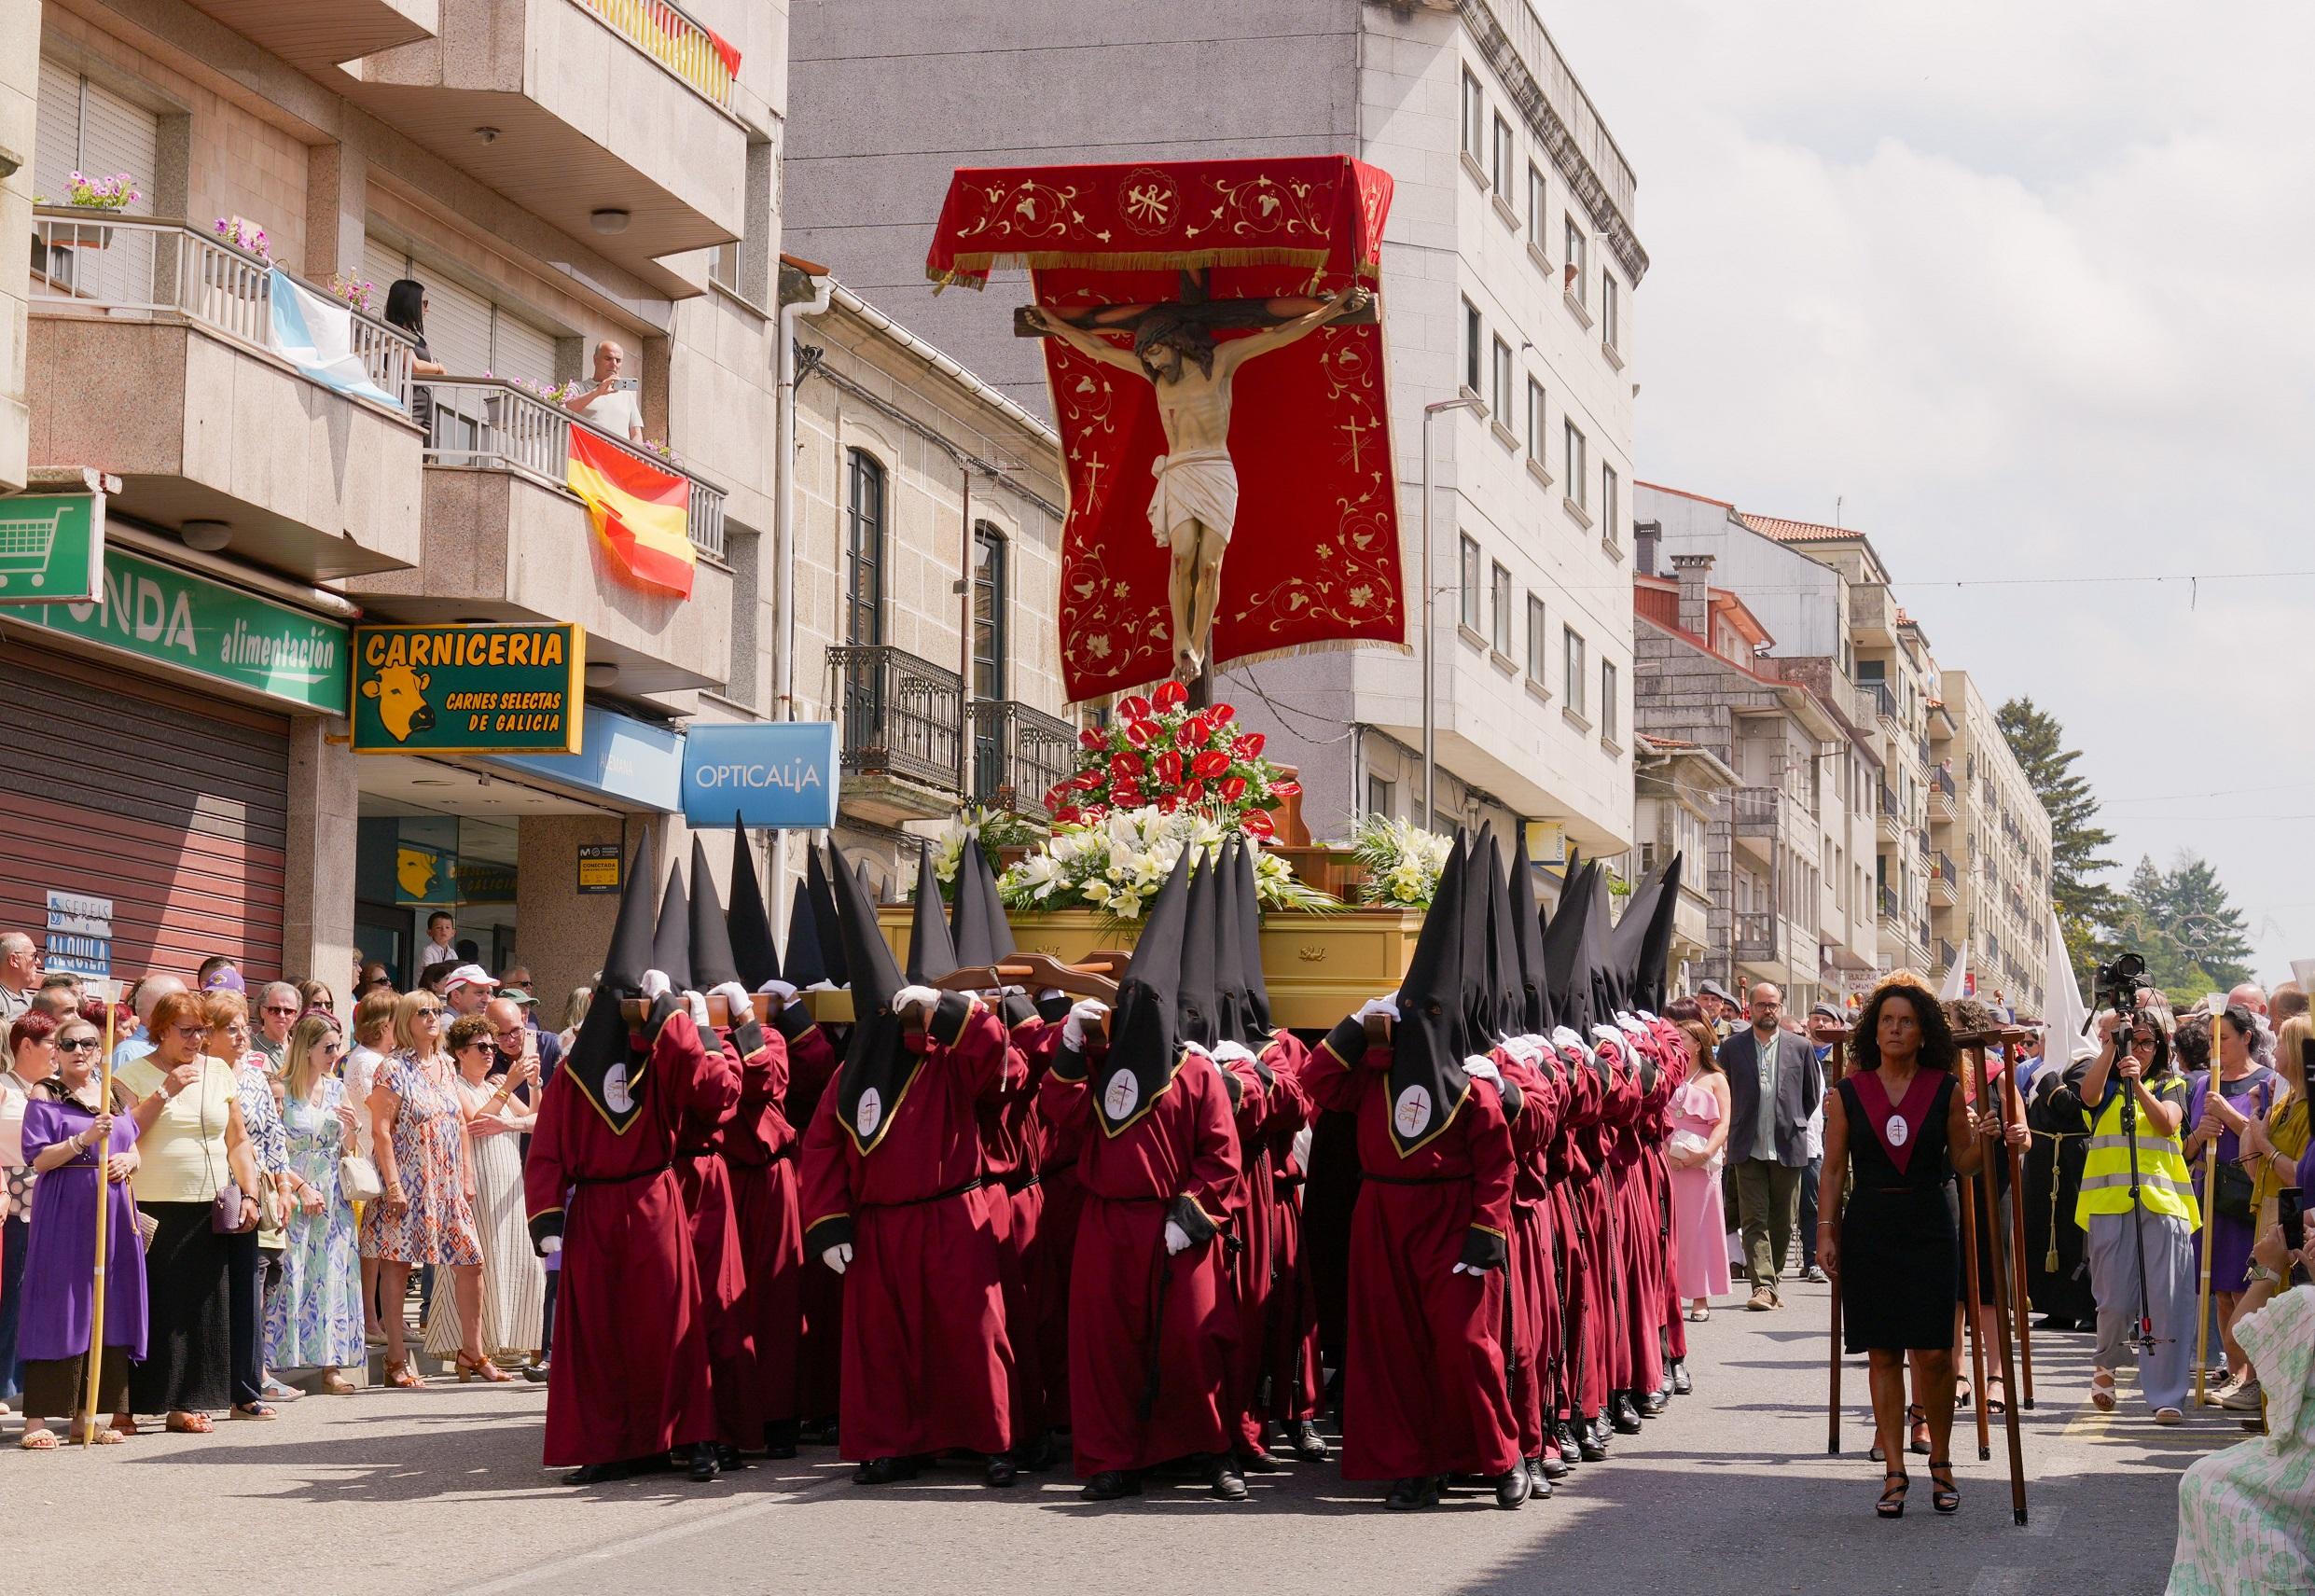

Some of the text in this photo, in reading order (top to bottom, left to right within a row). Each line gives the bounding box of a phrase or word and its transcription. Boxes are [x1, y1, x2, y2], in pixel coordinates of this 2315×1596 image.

[221, 618, 334, 669] alimentación
[365, 632, 563, 668] CARNICERIA
[445, 691, 562, 711] CARNES SELECTAS
[468, 714, 561, 732] DE GALICIA
[48, 935, 106, 971] ALQUILA
